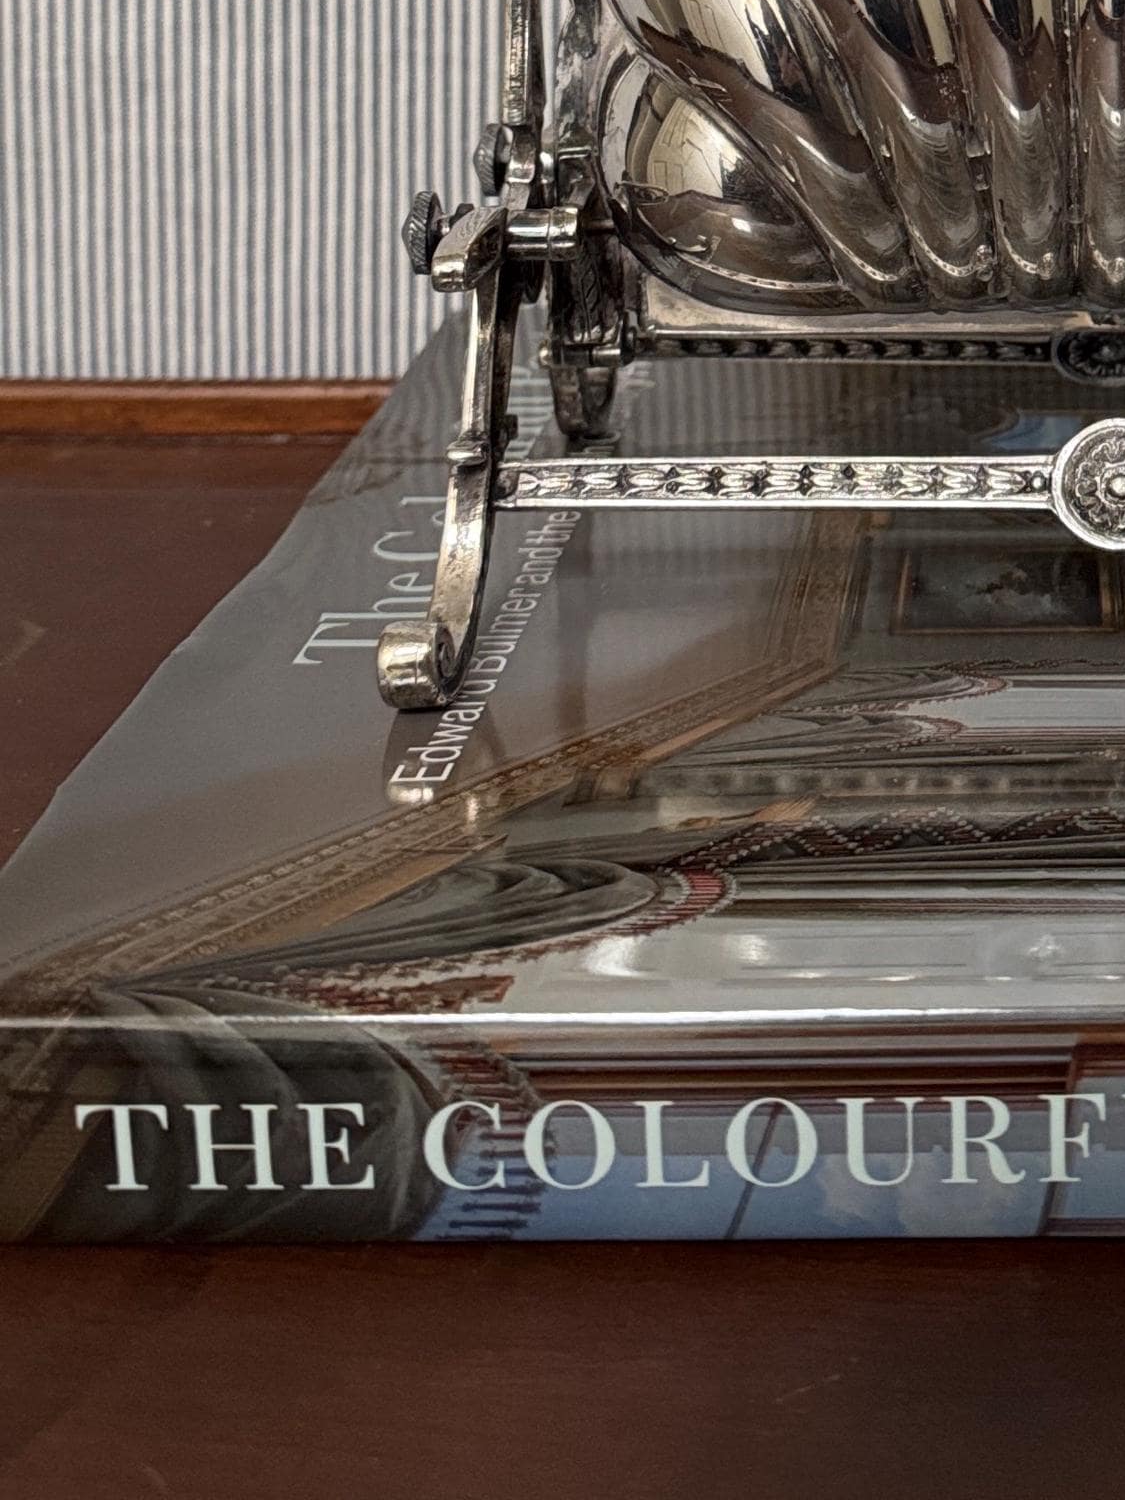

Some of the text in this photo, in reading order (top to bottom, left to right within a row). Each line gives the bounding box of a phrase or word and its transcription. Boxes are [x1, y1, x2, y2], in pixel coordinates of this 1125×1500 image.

[515, 547, 564, 586] and
[525, 510, 582, 545] the
[292, 572, 434, 665] The
[469, 588, 542, 672] Bulmer
[75, 1102, 376, 1192] THE
